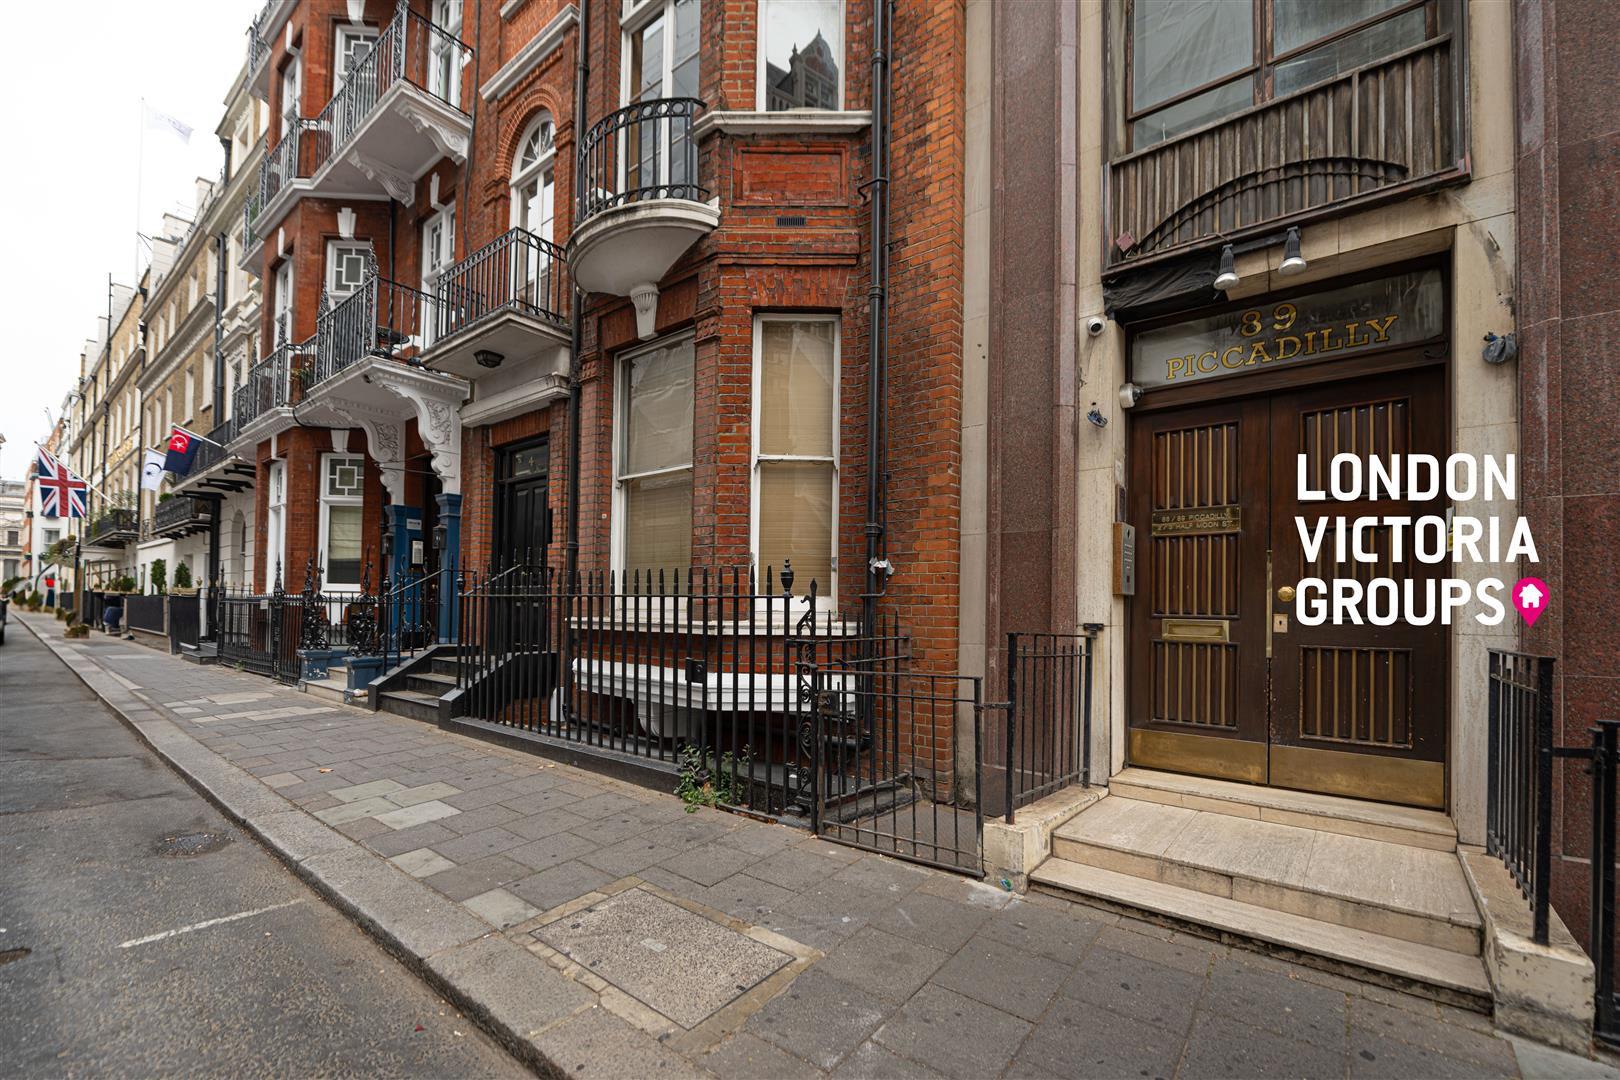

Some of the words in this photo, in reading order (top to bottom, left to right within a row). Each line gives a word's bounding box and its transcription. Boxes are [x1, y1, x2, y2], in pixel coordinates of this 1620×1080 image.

[1240, 303, 1297, 337] 89
[1166, 315, 1398, 380] PICCADILLY
[1196, 521, 1219, 529] MOON
